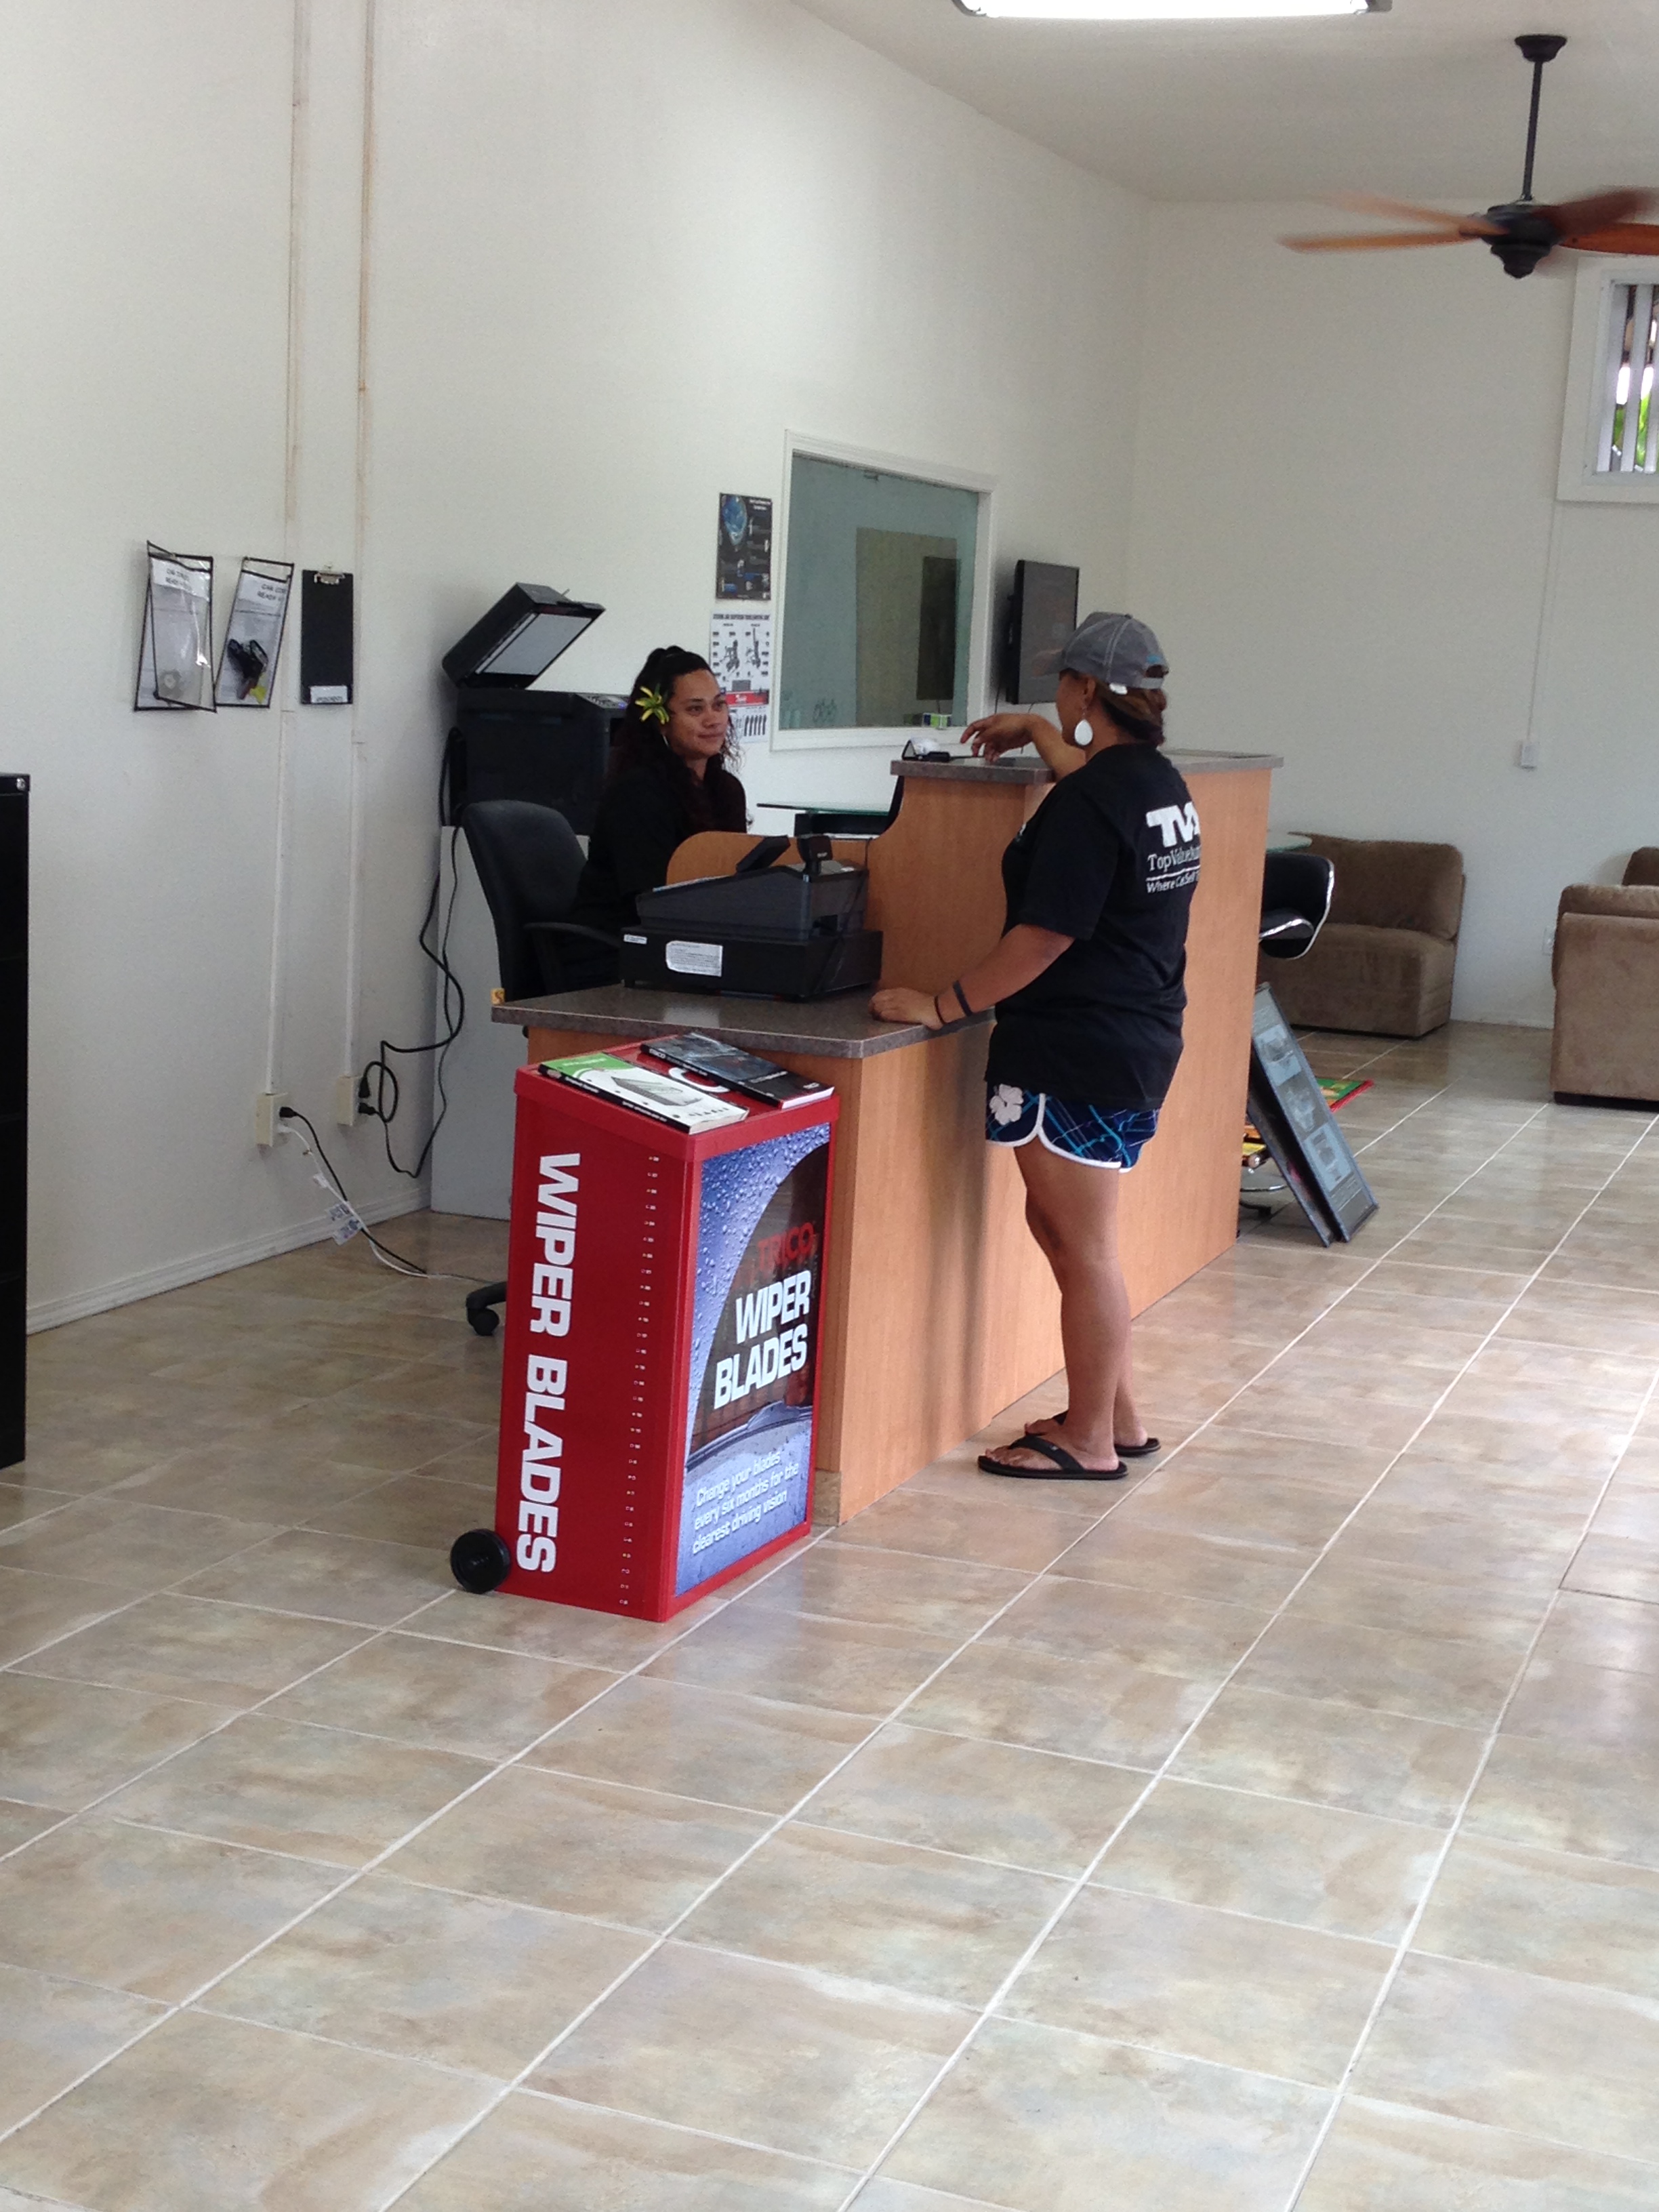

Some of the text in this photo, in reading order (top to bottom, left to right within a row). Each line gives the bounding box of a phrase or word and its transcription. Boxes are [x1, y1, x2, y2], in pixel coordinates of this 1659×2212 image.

[736, 1270, 811, 1345] WIPER
[516, 1153, 581, 1573] WIPER BLADES
[714, 1323, 808, 1410] BLADES
[693, 1490, 787, 1555] clearest driving vision
[695, 1462, 799, 1531] every six months for the
[696, 1479, 730, 1507] Change
[731, 1468, 752, 1492] your
